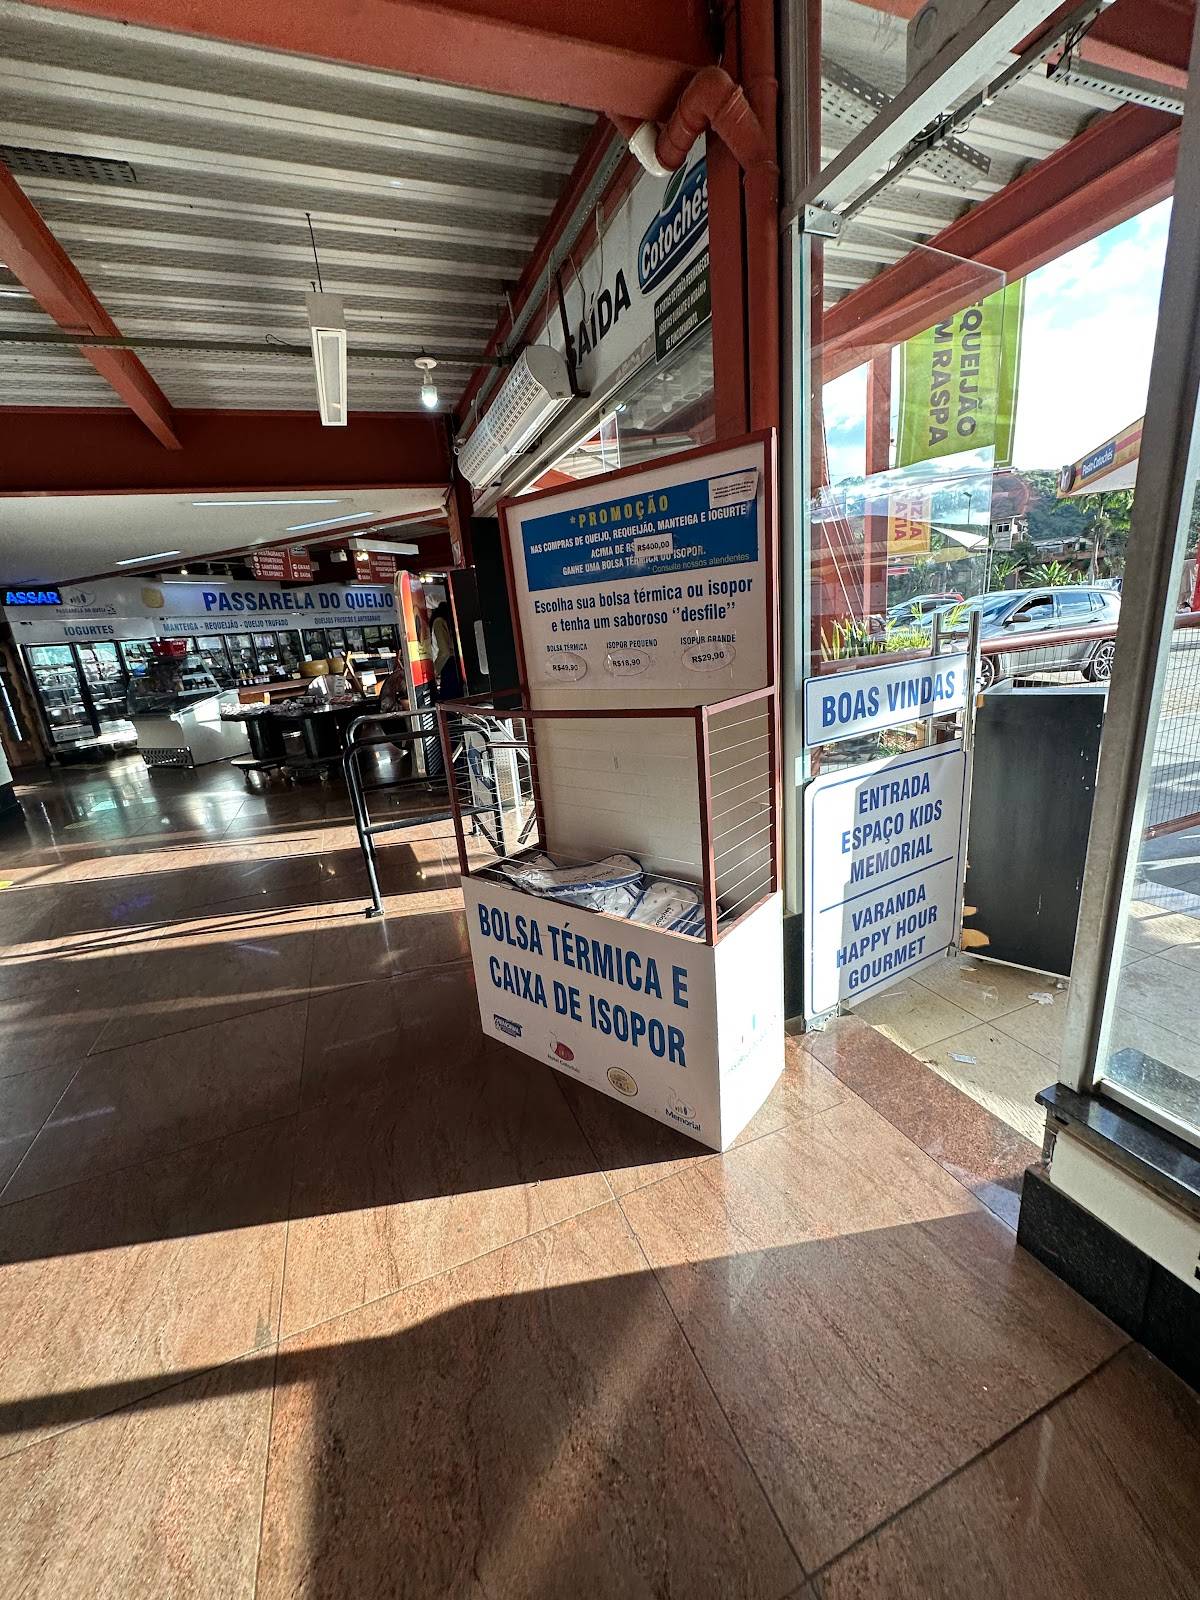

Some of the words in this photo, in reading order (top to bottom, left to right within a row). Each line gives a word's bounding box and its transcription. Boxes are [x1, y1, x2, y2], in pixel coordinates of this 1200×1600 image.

[934, 316, 954, 344] M
[956, 301, 983, 437] QUEIJÃO
[928, 348, 953, 447] RASPA
[530, 544, 542, 554] NAS
[543, 538, 574, 552] COMPRAS
[574, 536, 584, 545] DE
[585, 531, 612, 545] QUEIJO,
[613, 522, 655, 539] REQUEIJÃO,
[658, 514, 698, 531] MANTEIGA
[700, 512, 706, 522] E
[708, 505, 747, 521] IOGURTE
[562, 564, 584, 576] GANHE
[585, 562, 600, 573] UMA
[602, 558, 624, 570] BOLSA
[591, 547, 613, 558] ACIMA
[615, 545, 624, 555] DE
[682, 558, 707, 568] nossos
[709, 553, 750, 565] atendentes
[202, 591, 314, 612] PASSARELA
[320, 592, 341, 609] DO
[345, 592, 394, 610] QUEIJO
[534, 596, 574, 614] Escolha
[576, 596, 596, 609] sua
[599, 590, 630, 608] bolsa
[634, 584, 682, 605] térmica
[687, 583, 703, 597] ou
[708, 577, 753, 598] isopor
[64, 625, 114, 636] IOGURTES
[163, 622, 198, 632] MANTEIGA
[205, 620, 239, 630] REQUEIJÃO
[244, 620, 264, 628] QUEIJO
[551, 620, 558, 632] e
[560, 615, 590, 632] tenha
[593, 615, 610, 629] um
[613, 607, 668, 627] saboroso
[546, 645, 563, 653] BOLSA
[606, 641, 628, 649] ISOPOR
[629, 639, 658, 648] PEQUENO
[691, 651, 725, 664] R$29,90
[822, 686, 880, 727] BOAS
[887, 671, 955, 711] VINDAS
[859, 772, 930, 815] ENTRADA
[841, 813, 904, 854] ESPAÇO
[909, 799, 943, 832] KIDS
[850, 833, 933, 884] MEMORIAL
[852, 884, 927, 931] VARANDA
[836, 925, 890, 968] HAPPY
[896, 905, 938, 938] HOUR
[478, 903, 543, 955] BOLSA
[547, 922, 663, 1000] TÉRMICA
[671, 964, 690, 1009] E
[848, 935, 926, 990] GOURMET
[489, 955, 548, 1009] CAIXA
[552, 980, 583, 1023] DE
[589, 993, 688, 1068] ISOPOR
[665, 1107, 701, 1132] Memorial
